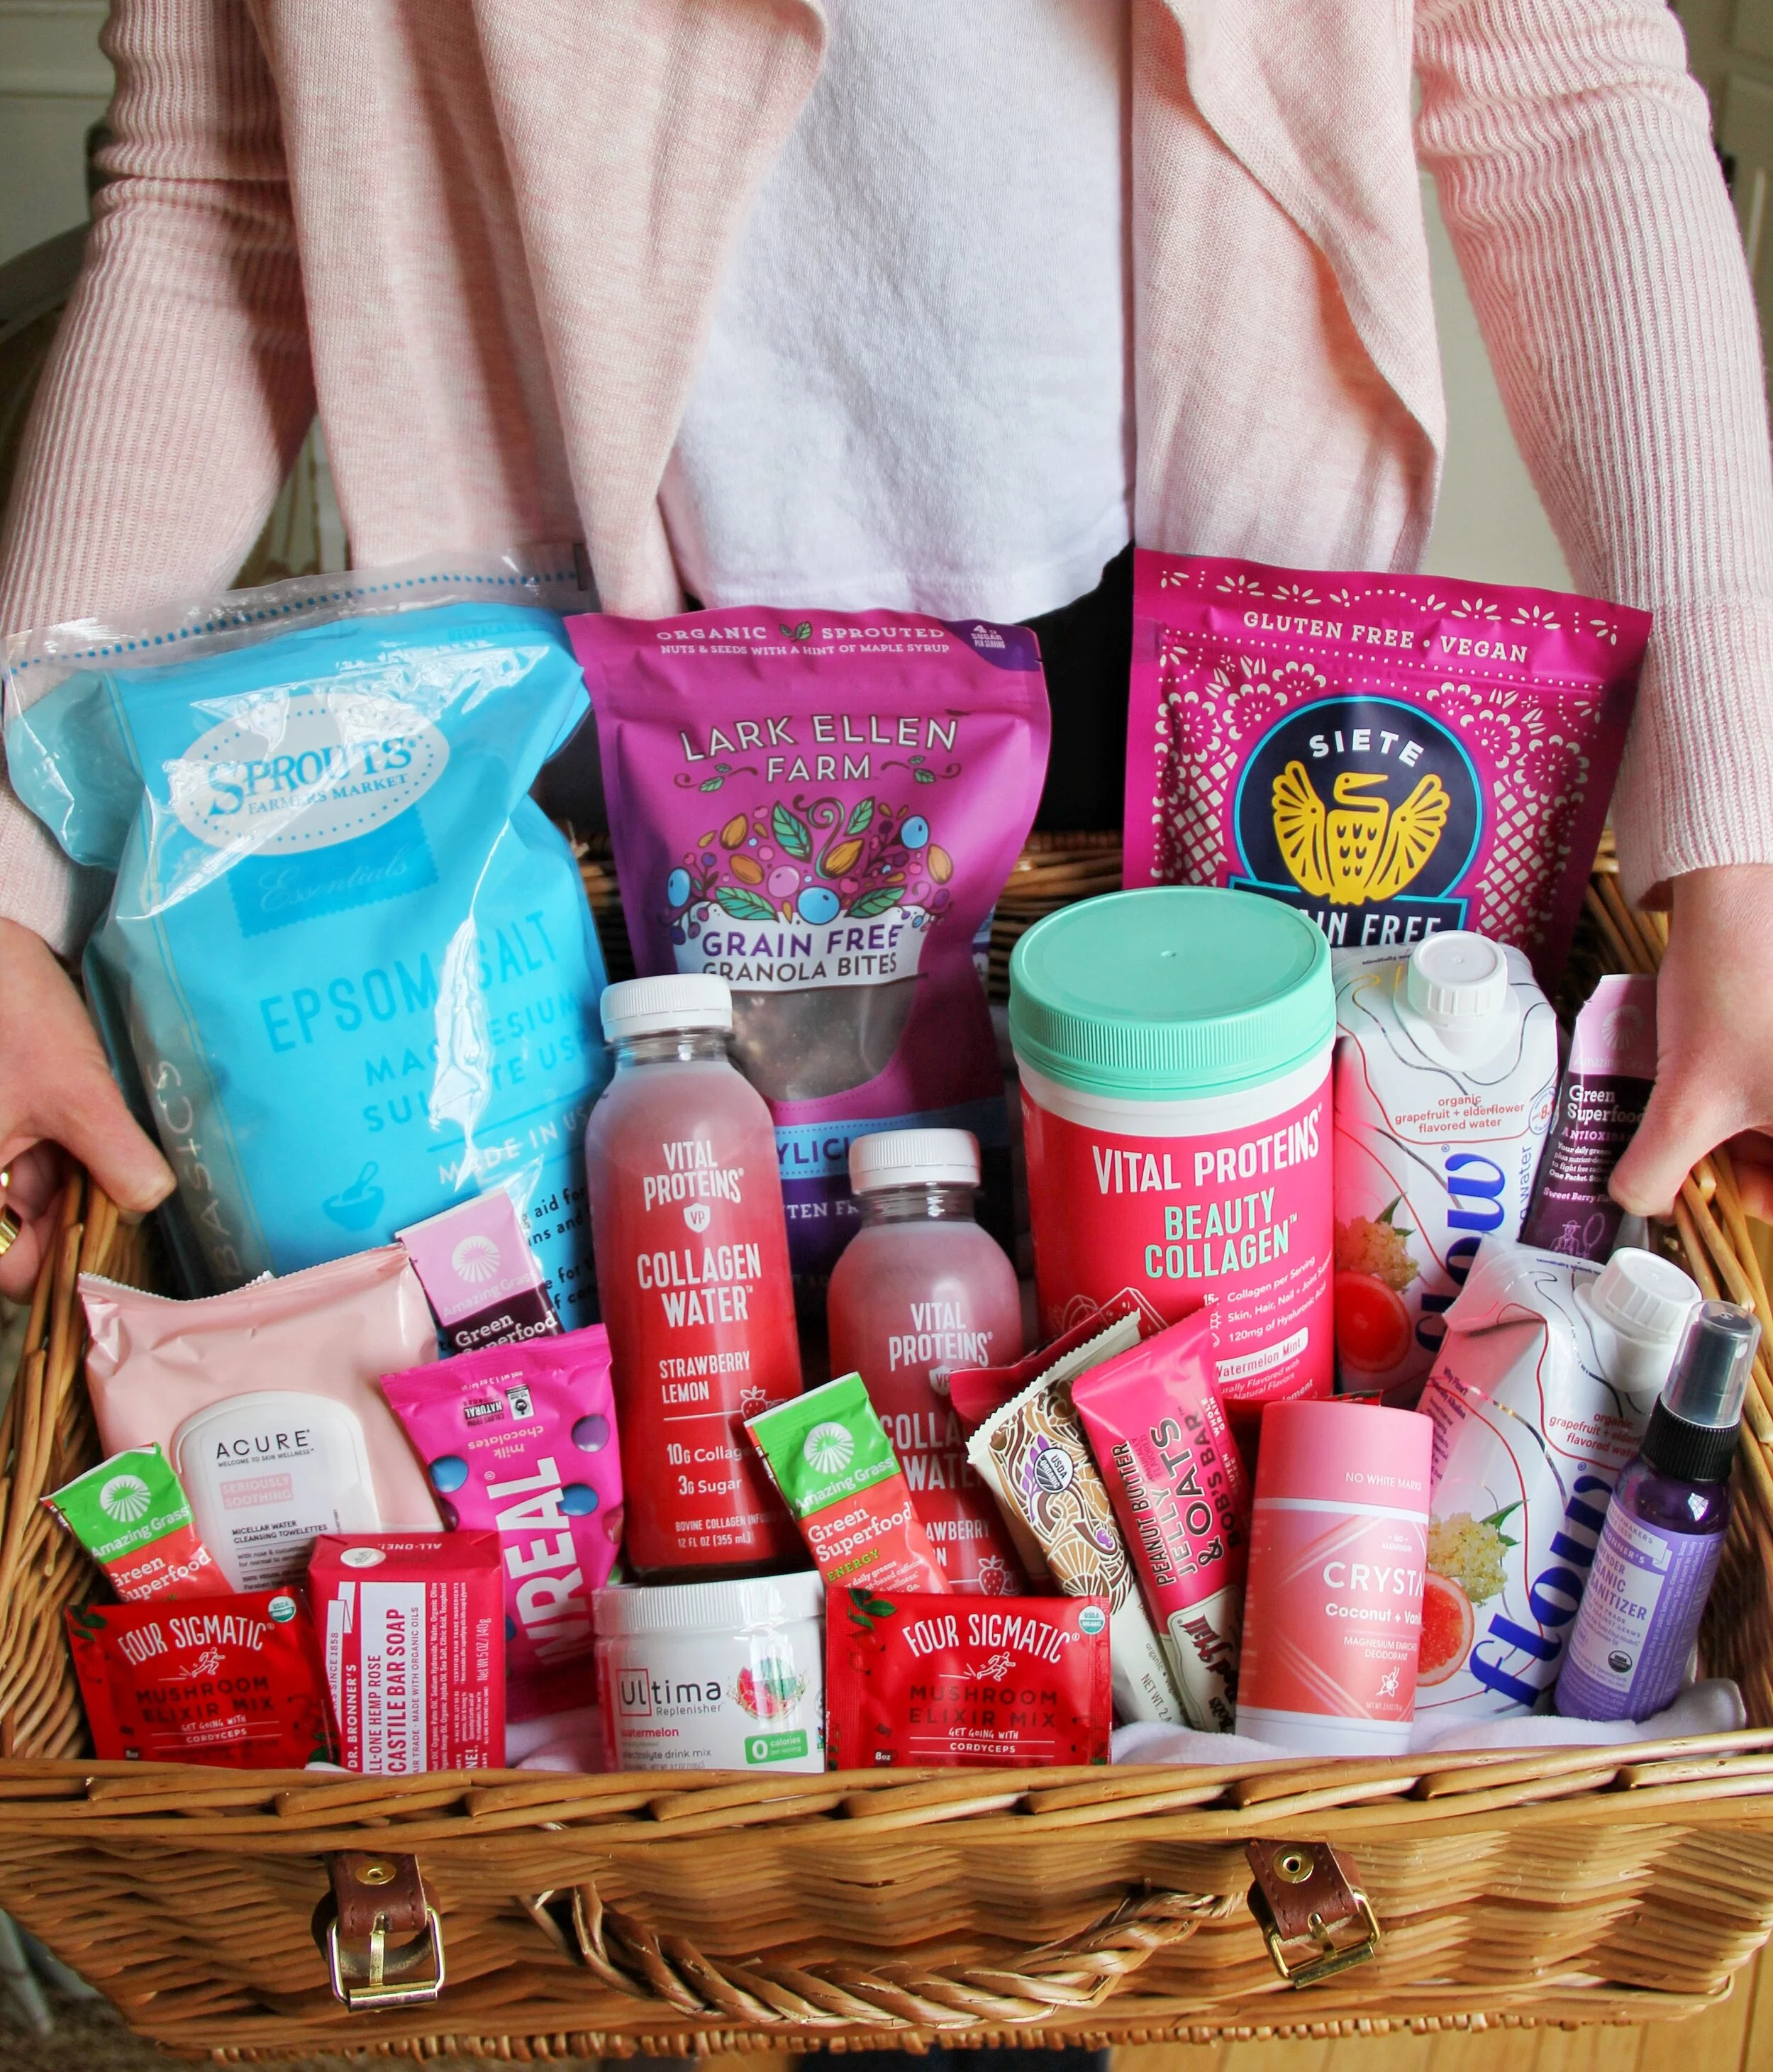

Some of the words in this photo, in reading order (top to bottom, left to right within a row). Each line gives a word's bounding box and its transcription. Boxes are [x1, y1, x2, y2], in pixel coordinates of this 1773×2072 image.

[657, 626, 767, 639] ORGANIC
[821, 627, 945, 639] SPROUTED
[1243, 611, 1343, 639] GLUTEN
[1351, 624, 1415, 650] FREE
[1440, 635, 1528, 664] VEGAN
[661, 645, 695, 654] NUTS
[711, 645, 747, 654] SEEDS
[751, 646, 787, 655] WITH
[803, 646, 835, 656] HINT
[839, 644, 855, 653] OF
[860, 643, 904, 653] MAPLE
[907, 643, 950, 654] SYRUP
[679, 715, 800, 763] LARK
[813, 714, 957, 752] ELLEN
[1309, 727, 1425, 768] SIETE
[207, 736, 413, 816] SPROUTS
[766, 754, 871, 784] FARM
[331, 773, 408, 800] MARKET
[701, 931, 813, 959] GRAIN
[826, 924, 904, 954] FREE
[702, 960, 828, 984] GRANOLA
[837, 953, 898, 978] BITES
[259, 952, 440, 1053] EPSOM
[1438, 1095, 1482, 1108] organic
[1569, 1084, 1616, 1102] Green
[1394, 1109, 1450, 1125] grapefruit
[1463, 1102, 1525, 1117] elderflower
[1418, 1120, 1467, 1134] flavored
[1469, 1117, 1502, 1129] water
[528, 1120, 559, 1150] IN
[661, 1139, 718, 1172] VITAL
[1091, 1143, 1182, 1195] VITAL
[1194, 1112, 1320, 1187] PROTEINS
[643, 1169, 742, 1212] PROTEINS
[1543, 1187, 1571, 1200] Sweet
[534, 1195, 560, 1218] aid
[689, 1210, 706, 1226] VP
[1164, 1186, 1276, 1241] BEAUTY
[1144, 1219, 1289, 1280] COLLAGEN
[636, 1243, 762, 1290] COLLAGEN
[1226, 1282, 1272, 1303] Collagen
[1273, 1275, 1289, 1290] per
[1289, 1256, 1316, 1279] Serving
[442, 1286, 501, 1319] Amazing
[660, 1285, 750, 1329] WATER
[909, 1301, 967, 1331] VITAL
[1227, 1309, 1252, 1324] Skin,
[1254, 1302, 1277, 1317] Hair,
[1277, 1289, 1295, 1306] Nail
[455, 1314, 514, 1347] Green
[1228, 1326, 1264, 1343] 120mg
[1265, 1318, 1276, 1332] of
[889, 1331, 991, 1373] PROTEINS
[1282, 1338, 1301, 1357] Mint
[659, 1350, 751, 1380] STRAWBERRY
[662, 1380, 710, 1405] LEMON
[464, 1401, 504, 1419] NATURAL
[1200, 1397, 1221, 1438] WHOLE
[1208, 1395, 1225, 1435] GRAIN
[467, 1424, 545, 1451] chocolates
[1183, 1410, 1217, 1467] BAR
[1549, 1416, 1601, 1436] grapefruit
[216, 1429, 309, 1460] ACURE
[493, 1443, 526, 1460] milk
[1566, 1431, 1611, 1452] flavored
[218, 1458, 250, 1468] WELCOME
[277, 1449, 311, 1459] WELLNESS
[1039, 1458, 1060, 1489] ORGANIC
[1051, 1454, 1067, 1480] USDA
[221, 1475, 290, 1494] SERIOUSLY
[698, 1478, 743, 1495] Sugar
[794, 1476, 857, 1513] Amazing
[854, 1457, 895, 1483] Grass
[1111, 1440, 1152, 1514] BUTTER
[1149, 1416, 1213, 1537] OATS
[1345, 1471, 1365, 1483] NO
[1367, 1473, 1395, 1487] WHITE
[1397, 1478, 1423, 1492] MARKS
[225, 1490, 292, 1508] SOOTHING
[91, 1526, 152, 1558] Amazing
[150, 1505, 190, 1531] Grass
[231, 1524, 269, 1536] MICELLAR
[271, 1520, 297, 1529] WATER
[233, 1531, 277, 1544] CLEANSING
[279, 1524, 328, 1537] TOWELETTES
[674, 1519, 703, 1532] BOVINE
[705, 1516, 747, 1530] COLLAGEN
[807, 1507, 869, 1544] Green
[815, 1500, 913, 1563] Superfood
[1149, 1487, 1199, 1578] JELLY
[379, 1541, 443, 1551] ALL-ONE!
[677, 1537, 687, 1548] 12
[689, 1536, 697, 1548] FL
[1135, 1517, 1177, 1588] PEANUT
[1196, 1534, 1225, 1568] &
[485, 1456, 592, 1665] NREAL
[826, 1549, 880, 1582] ENERGY
[872, 1561, 897, 1579] greens
[1469, 1473, 1614, 1707] flow
[411, 1606, 420, 1631] OILS
[1325, 1602, 1392, 1622] Coconut
[117, 1622, 169, 1666] FOUR
[169, 1614, 267, 1651] SIGMATIC
[330, 1632, 339, 1651] 1858
[386, 1608, 406, 1656] SOAP
[901, 1614, 960, 1658] FOUR
[968, 1612, 1071, 1664] SIGMATIC
[1343, 1636, 1395, 1649] MAGNESIUM
[411, 1632, 420, 1675] ORGANIC
[1145, 1642, 1165, 1672] organic
[1365, 1649, 1408, 1662] DEODORANT
[330, 1652, 338, 1692] SINCE
[367, 1655, 382, 1688] ROSE
[386, 1661, 406, 1697] BAR
[135, 1675, 270, 1705] MUSHROOM
[411, 1675, 420, 1699] WITH
[621, 1679, 722, 1707] Ultima
[909, 1684, 1058, 1707] MUSHROOM
[1140, 1673, 1156, 1695] NET
[1150, 1691, 1165, 1711] WT.
[142, 1702, 220, 1723] ELIXIR
[231, 1696, 274, 1713] MIX
[345, 1663, 358, 1744] BRONNER'S
[368, 1690, 382, 1729] HEMP
[411, 1700, 420, 1722] MADE
[656, 1703, 722, 1717] Replenisher
[908, 1708, 996, 1726] ELIXIR
[1010, 1712, 1056, 1729] MIX
[185, 1727, 248, 1744] CORDYCEPS
[387, 1700, 407, 1773] CASTILE
[411, 1728, 420, 1754] TRADE
[950, 1741, 1016, 1754] CORDYCEPS
[998, 1729, 1018, 1740] WITH
[346, 1747, 359, 1769] DR.
[665, 1748, 691, 1759] drink
[692, 1747, 712, 1758] mix
[752, 1739, 769, 1761] 0
[874, 1751, 891, 1761] 8oz
